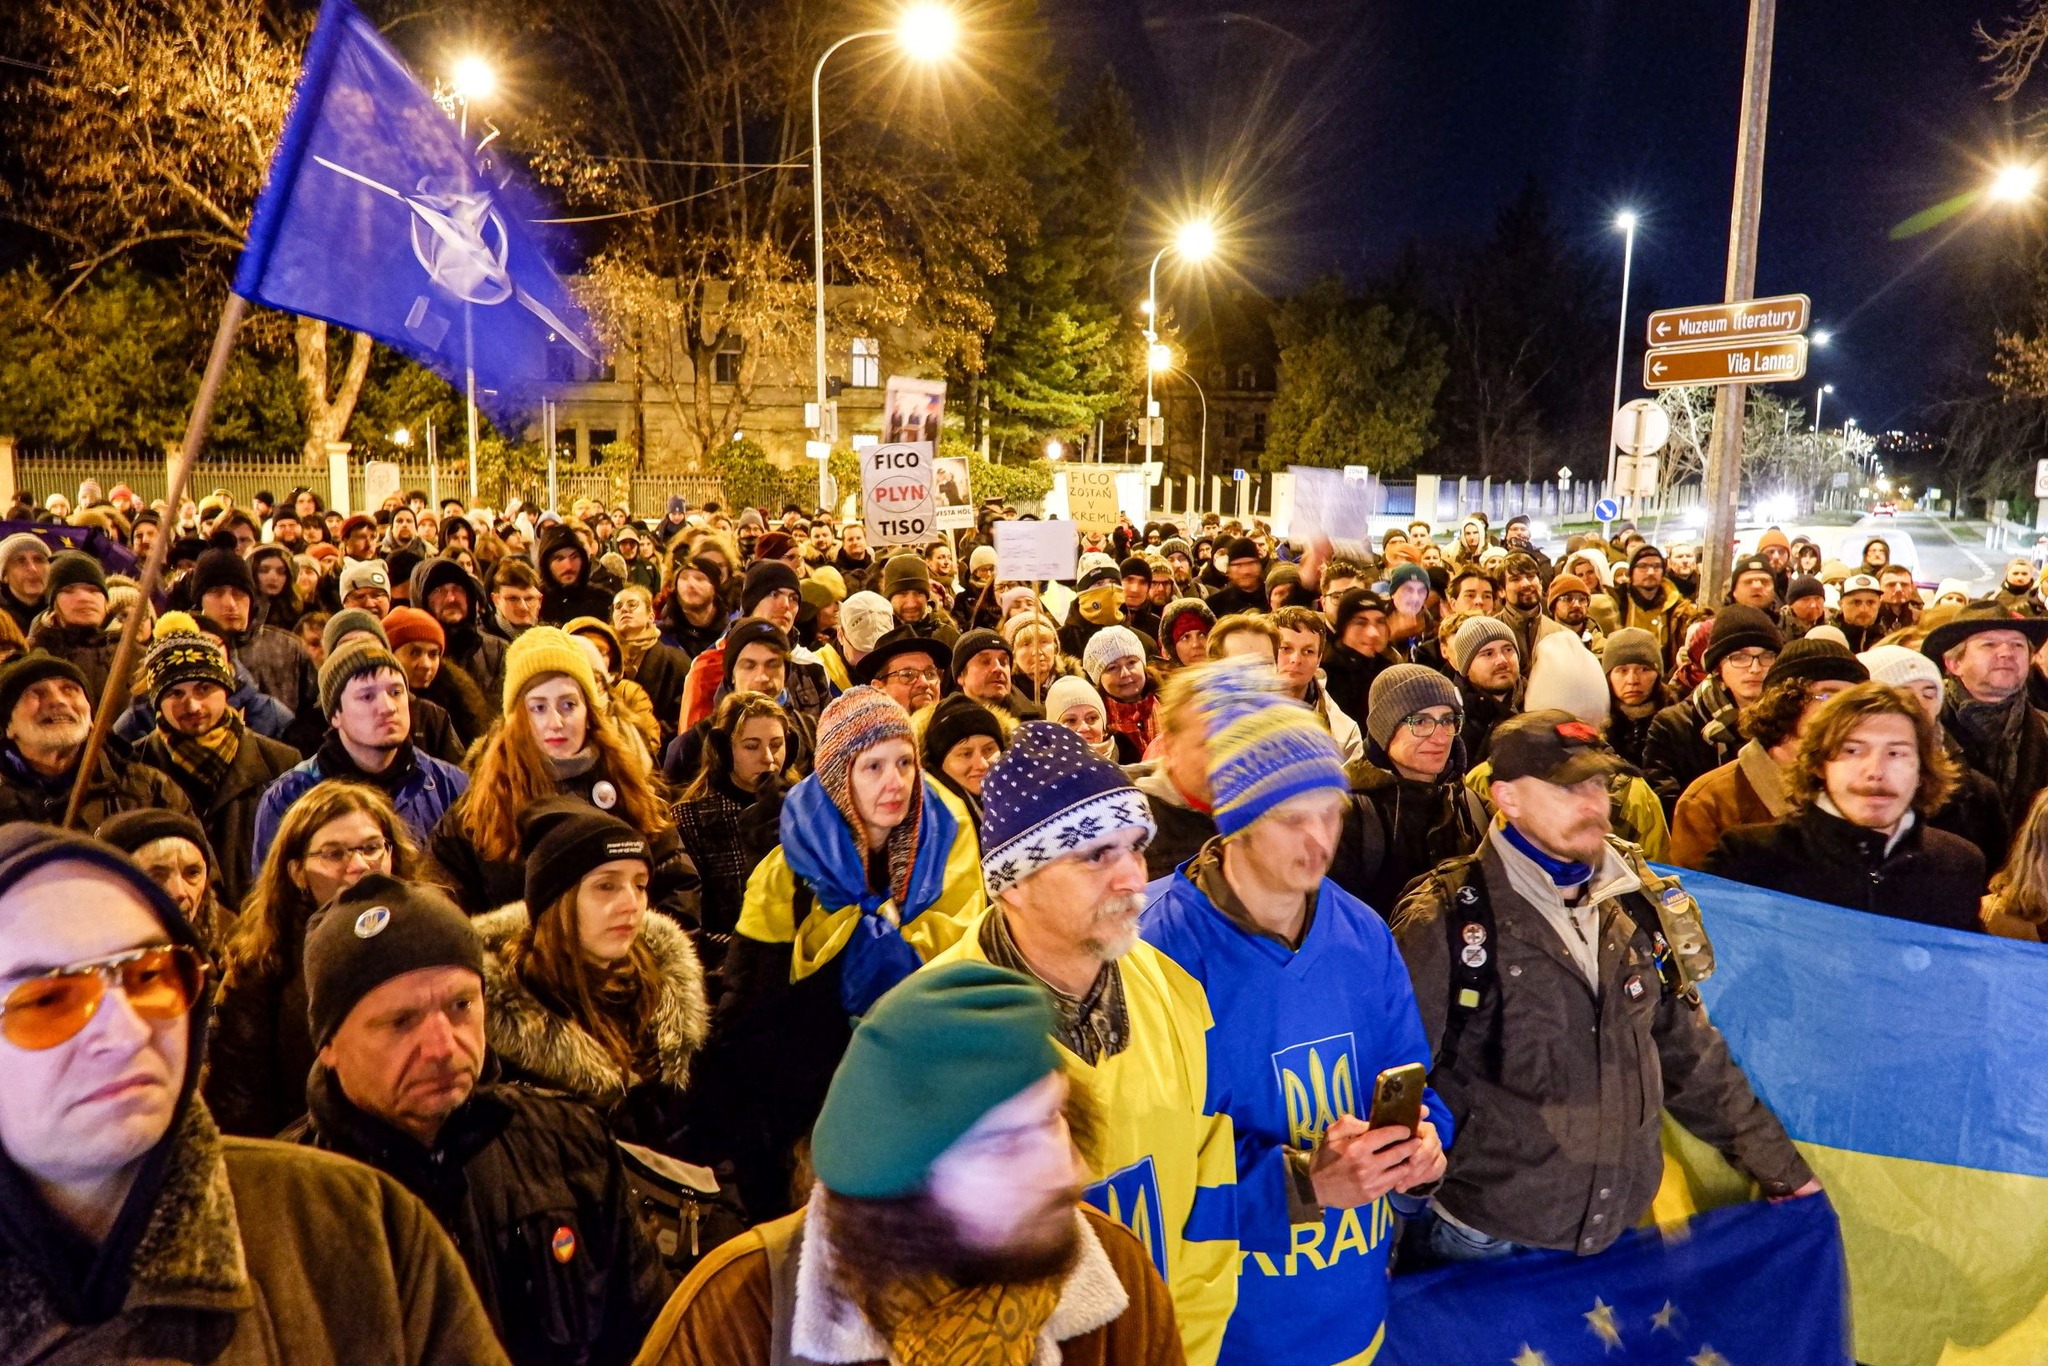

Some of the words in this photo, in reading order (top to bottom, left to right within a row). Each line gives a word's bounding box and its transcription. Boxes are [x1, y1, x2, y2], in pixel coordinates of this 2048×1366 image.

[1678, 317, 1727, 336] Muzeum
[1733, 311, 1796, 330] literatury
[1727, 353, 1751, 374] Vila
[1754, 351, 1794, 372] Lanna
[875, 452, 919, 470] FICO
[1071, 472, 1109, 485] FICO
[875, 485, 924, 503] PLYN
[1088, 500, 1094, 509] V
[878, 519, 925, 536] TISO
